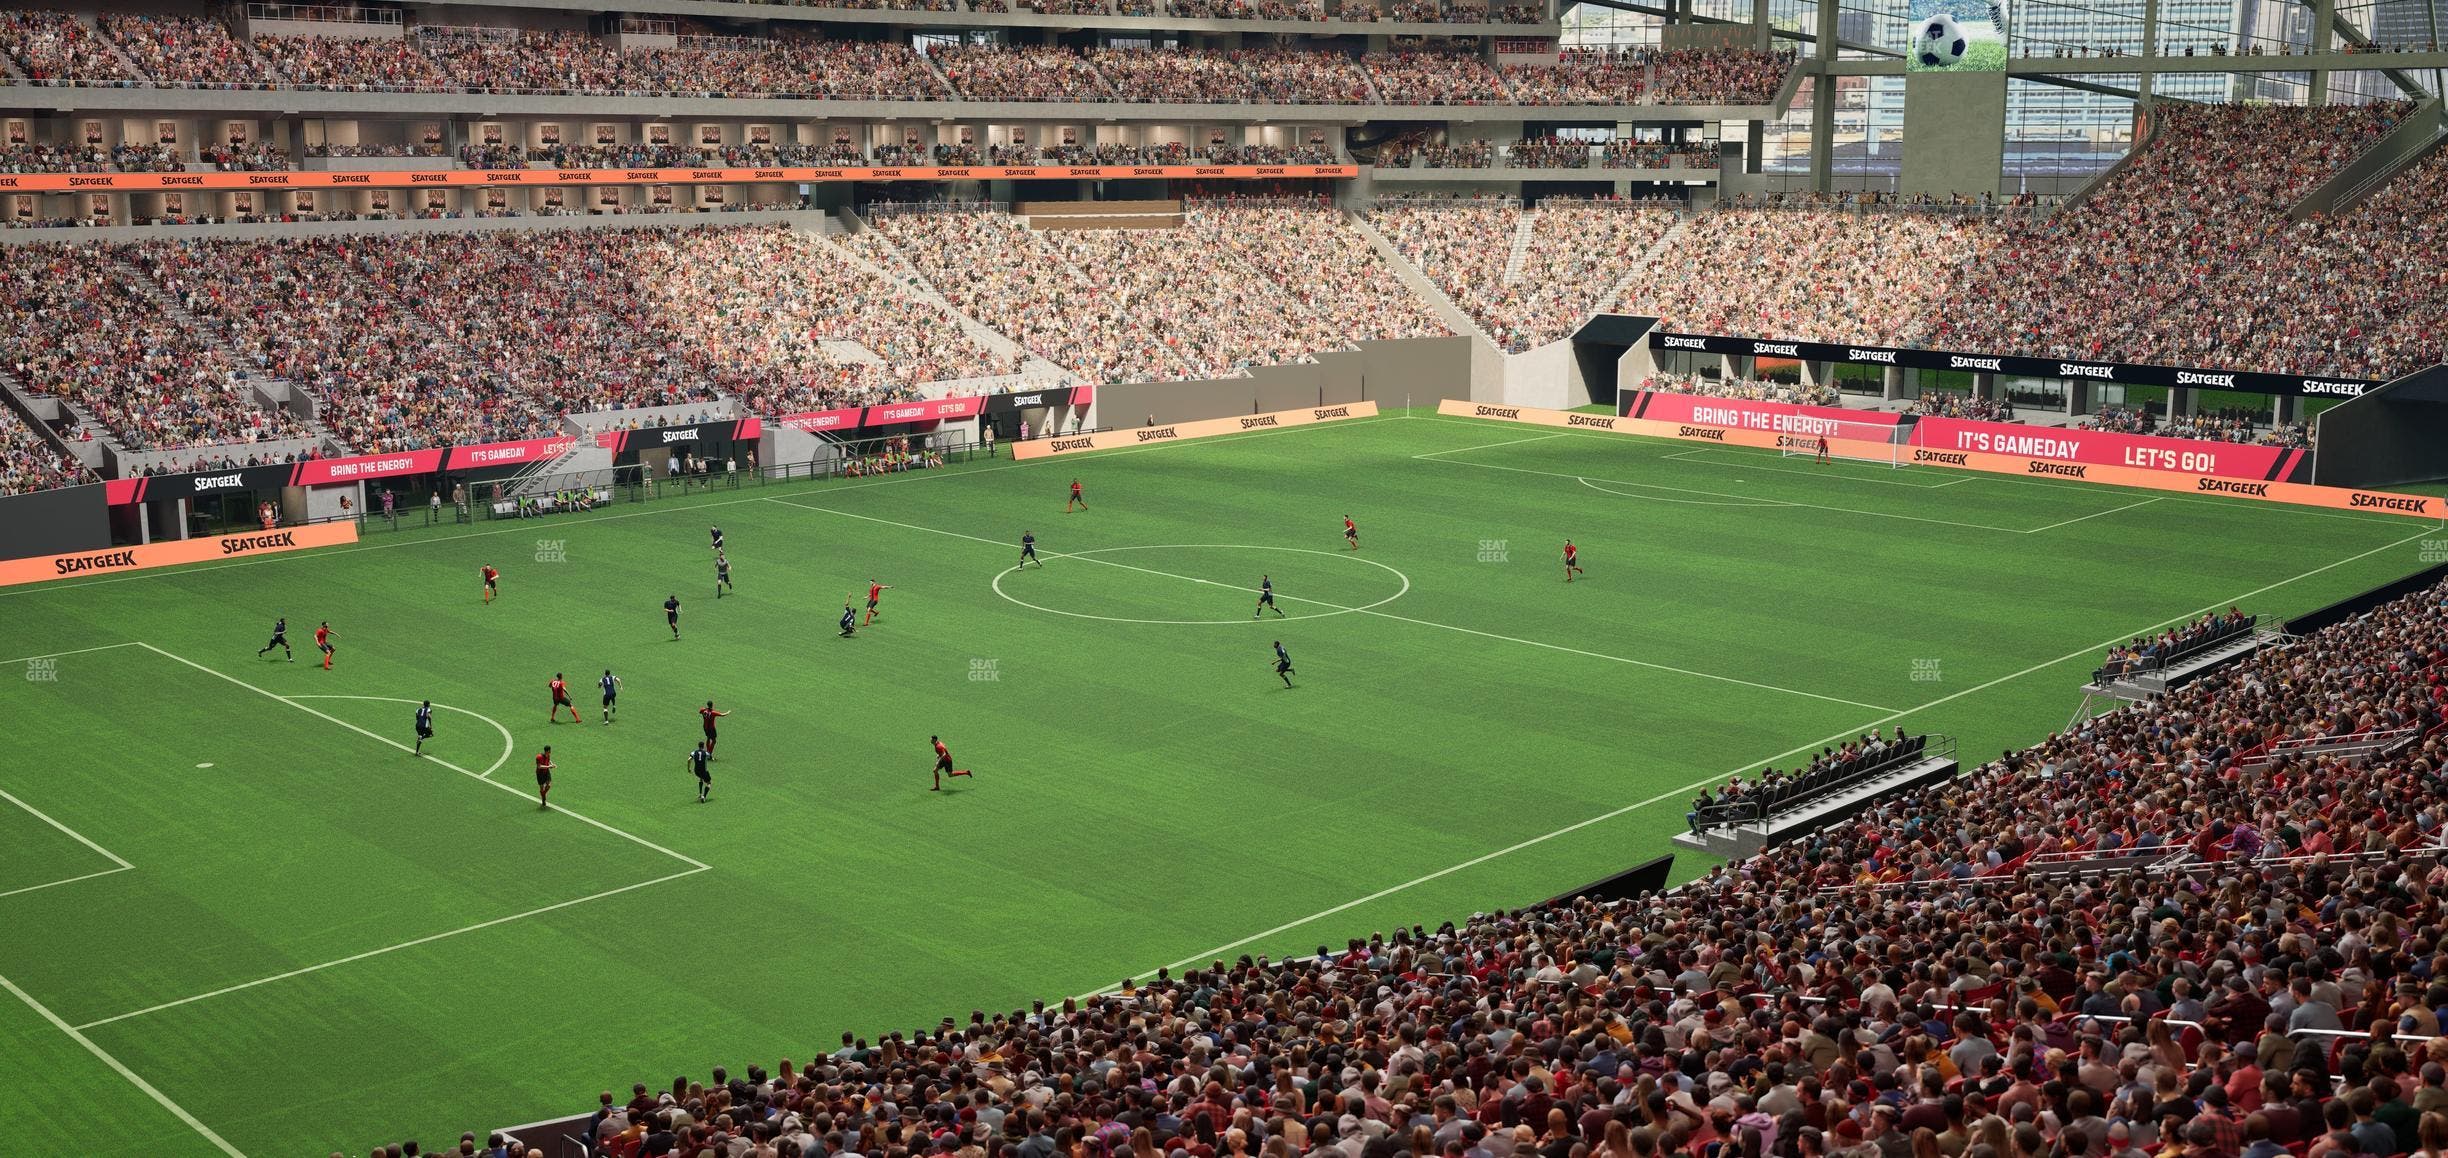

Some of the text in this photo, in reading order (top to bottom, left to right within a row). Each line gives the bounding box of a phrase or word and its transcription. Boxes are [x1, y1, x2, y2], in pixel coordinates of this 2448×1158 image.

[487, 174, 521, 182] SEATGEEK
[559, 173, 591, 181] SEATGEEK
[755, 170, 783, 179] SEATGEEK
[815, 170, 842, 178] SEATGEEK
[873, 169, 901, 177] SEATGEEK
[938, 169, 969, 177] SEATGEEK
[1071, 168, 1100, 176] SEATGEEK
[1134, 168, 1163, 176] SEATGEEK
[1257, 167, 1284, 175] SEATGEEK
[1315, 167, 1342, 175] SEATGEEK
[69, 177, 113, 187] SEATGEEK
[162, 177, 203, 186] SEATGEEK
[250, 176, 288, 184] SEATGEEK
[333, 175, 370, 183] SEATGEEK
[412, 175, 447, 183] SEATGEEK
[1664, 336, 1706, 350] SEATGEEK
[1753, 342, 1798, 357] SEATGEEK
[1849, 348, 1896, 364] SEATGEEK
[1950, 356, 2001, 371] SEATGEEK
[2059, 363, 2114, 380] SEATGEEK
[2176, 371, 2235, 388] SEATGEEK
[2302, 379, 2365, 396] SEATGEEK
[937, 402, 966, 414] LET'S GO!
[1013, 394, 1042, 407] SEATGEEK
[883, 407, 925, 419] IT'S GAMEDAY
[1314, 406, 1350, 421] SEATGEEK
[1475, 405, 1520, 420] SEATGEEK
[813, 416, 840, 427] ENERGY!
[1240, 415, 1278, 430] SEATGEEK
[1567, 414, 1615, 430] SEATGEEK
[1693, 406, 1838, 436] BRING THE ENERGY!
[662, 428, 699, 443] SEATGEEK
[1136, 427, 1178, 442] SEATGEEK
[1678, 426, 1725, 441] SEATGEEK
[1050, 436, 1094, 453] SEATGEEK
[1776, 435, 1820, 451] SEATGEE
[1958, 431, 2079, 460] IT'S GAMEDAY
[471, 446, 525, 462] IT'S GAMEDAY
[1913, 449, 1968, 466] SEATGEEK
[2124, 447, 2215, 473] LET'S GO!
[330, 458, 413, 476] BRING THE ENERGY!
[2028, 460, 2087, 479] SEATGEEK
[194, 473, 243, 491] SEATGEEK
[2197, 477, 2268, 497] SEATGEEK
[2350, 493, 2428, 514] SEATGEEK
[221, 531, 296, 555] SEATGEEK
[55, 550, 137, 575] SEATGEEK
